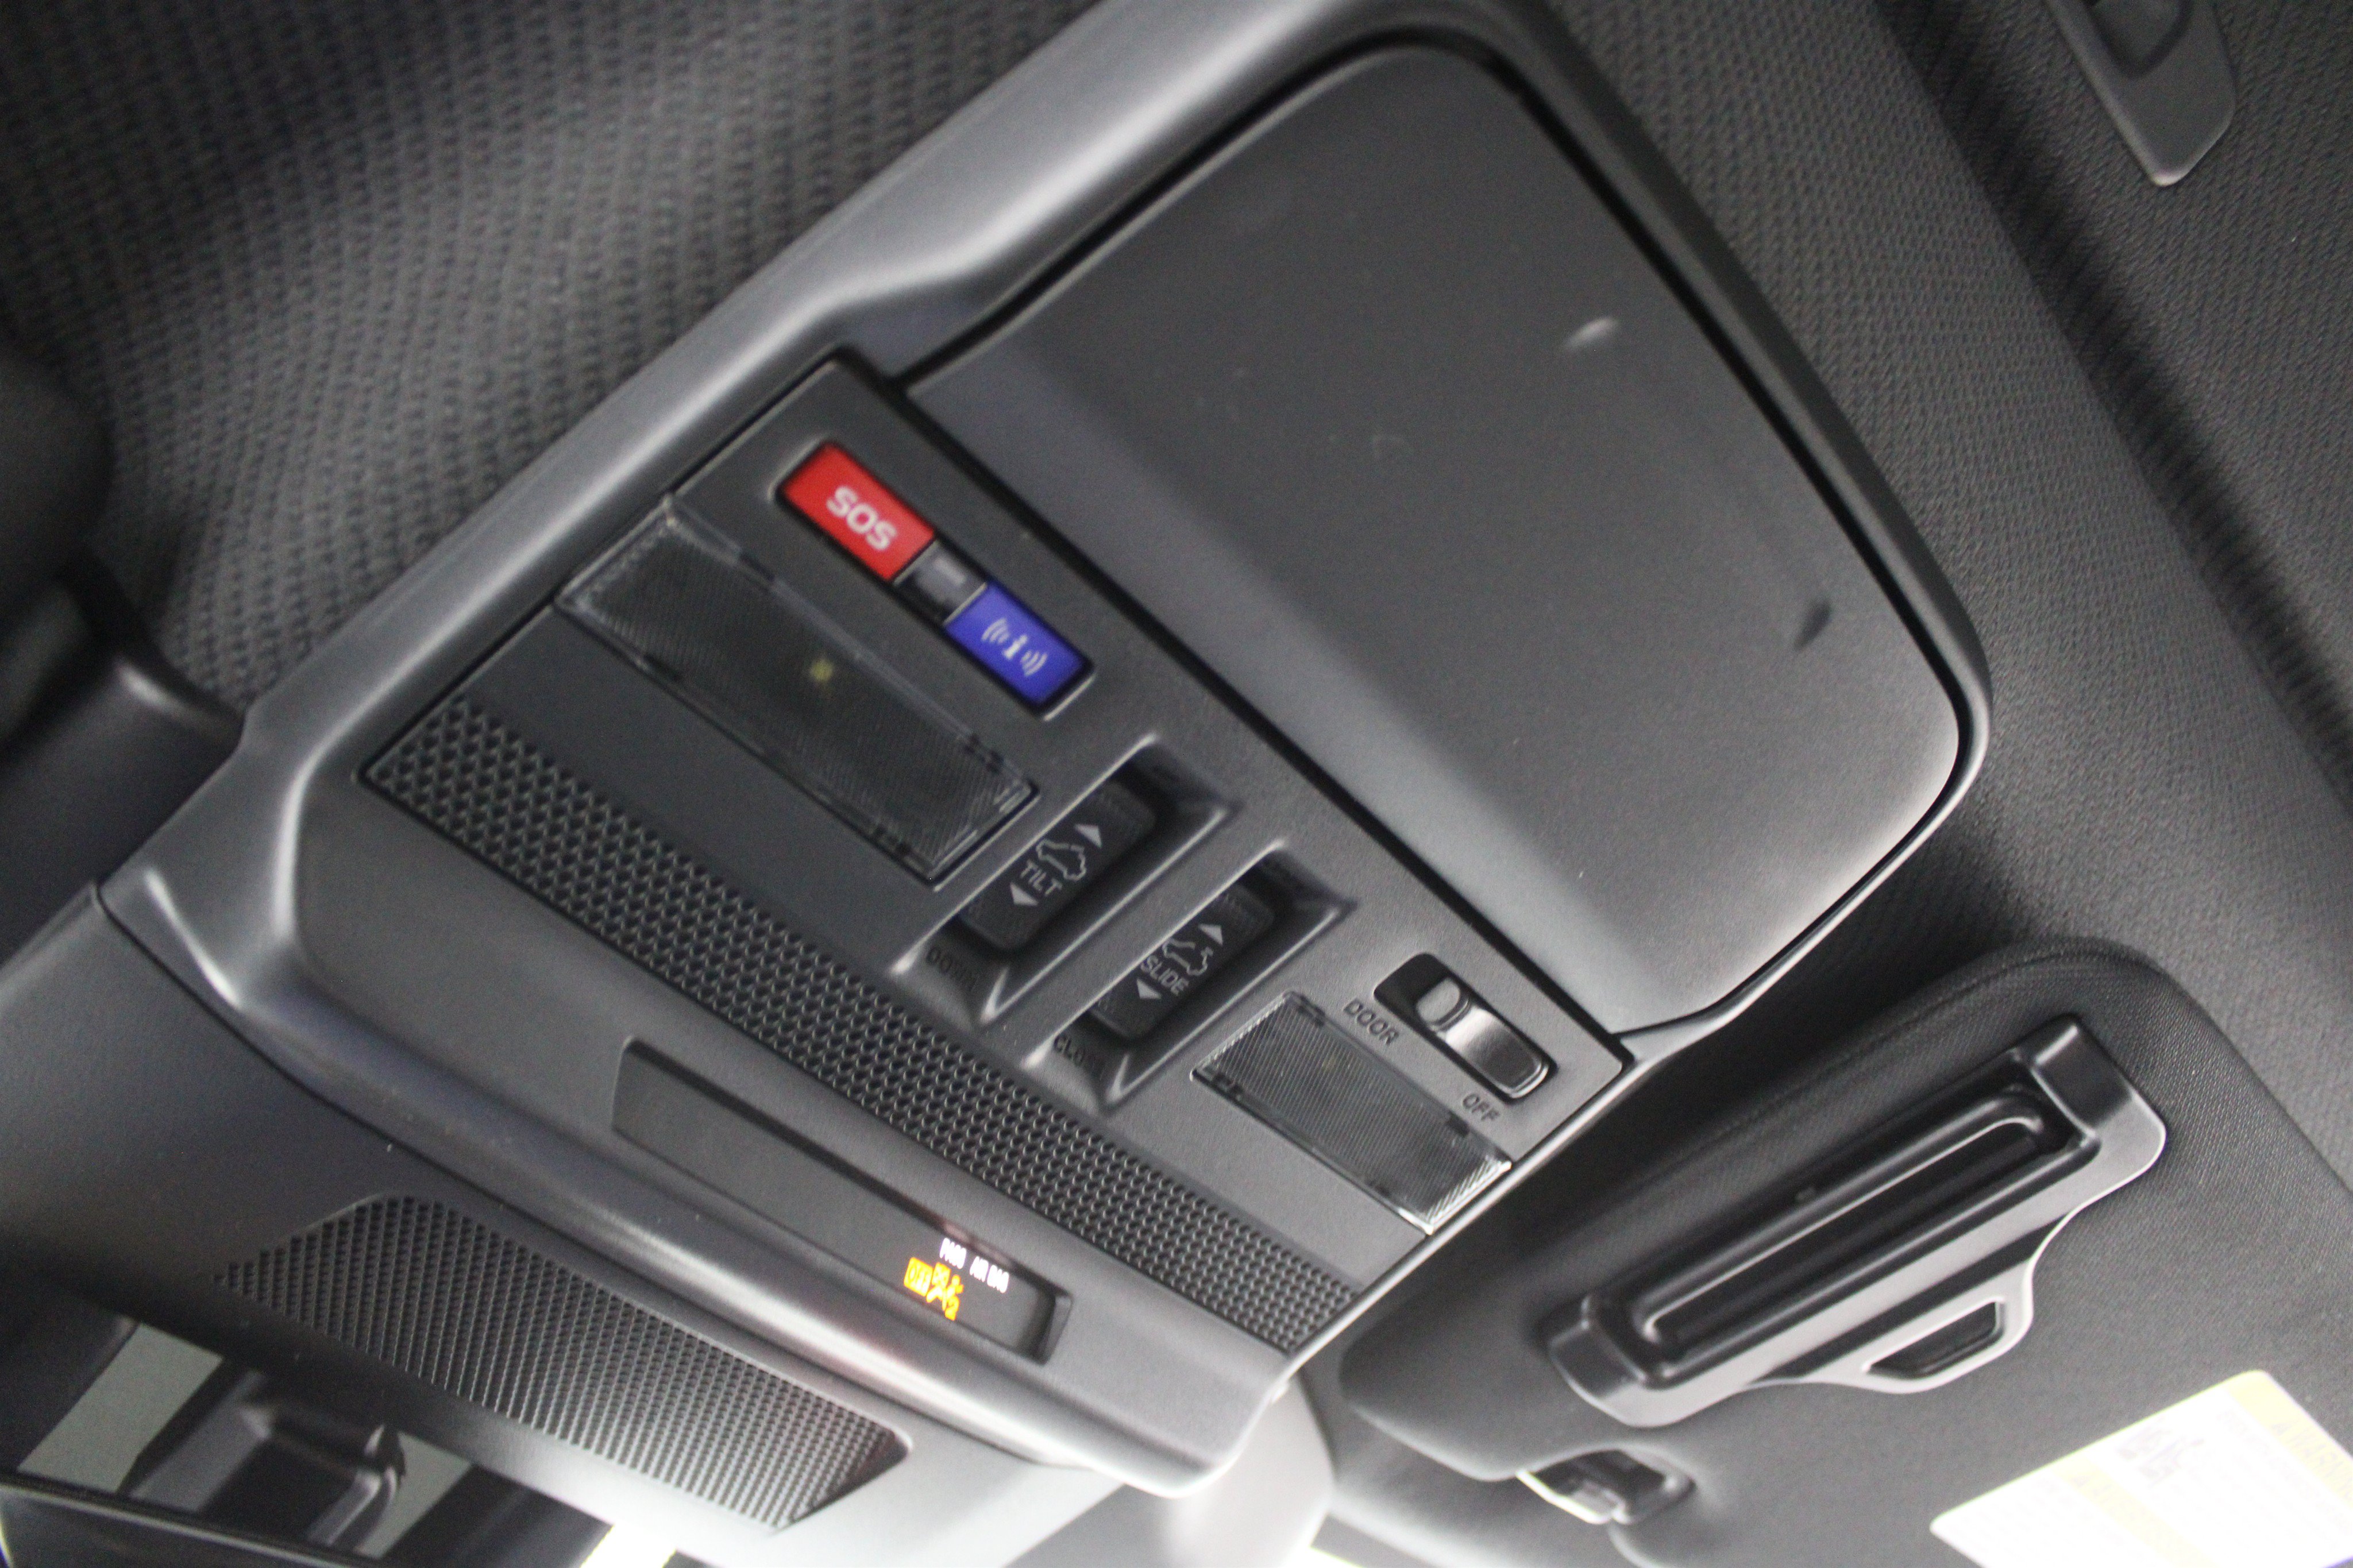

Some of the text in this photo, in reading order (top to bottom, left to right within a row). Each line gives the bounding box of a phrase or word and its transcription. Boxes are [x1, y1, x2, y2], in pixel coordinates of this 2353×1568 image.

[826, 486, 896, 550] SOS
[1021, 860, 1062, 895] TILT
[1141, 954, 1189, 995] SLIDE
[1344, 998, 1399, 1045] DOOR
[1463, 1094, 1500, 1121] OFF
